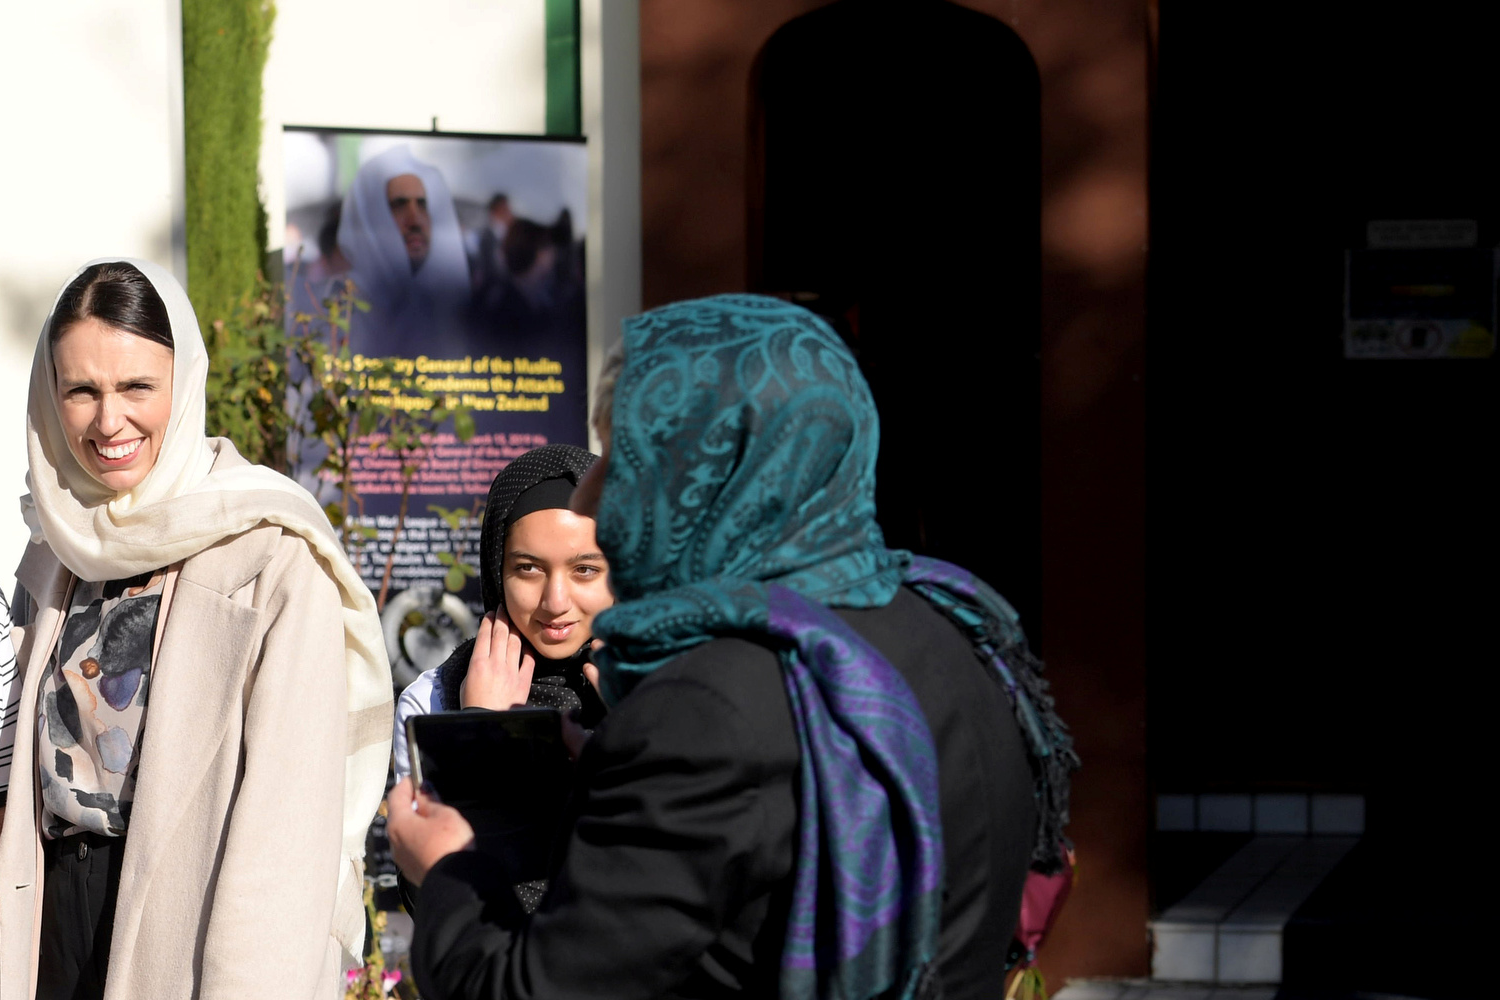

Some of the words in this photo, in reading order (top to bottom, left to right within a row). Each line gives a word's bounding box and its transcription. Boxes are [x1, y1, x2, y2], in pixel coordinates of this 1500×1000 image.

[416, 354, 472, 374] General
[473, 355, 490, 373] of
[490, 356, 513, 374] the
[514, 356, 562, 375] Muslim
[416, 374, 490, 393] Condemns
[491, 374, 514, 393] the
[515, 375, 565, 394] Attacks
[496, 394, 550, 412] Zealand
